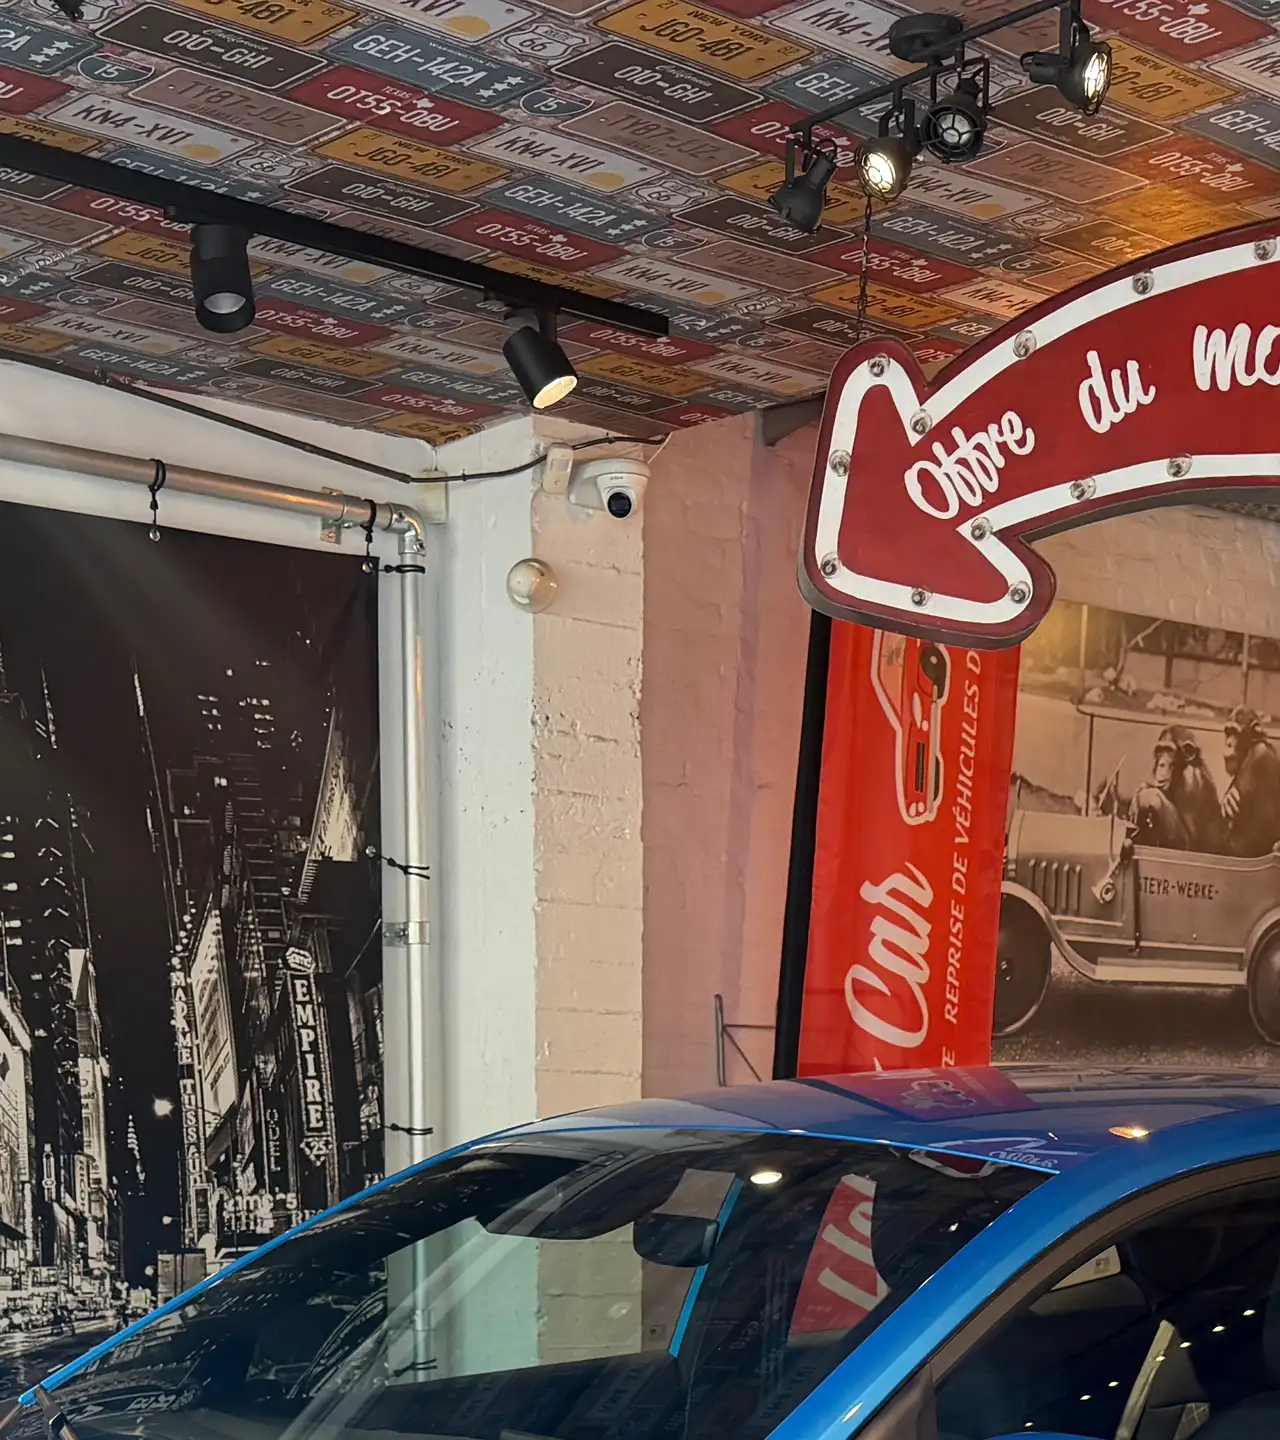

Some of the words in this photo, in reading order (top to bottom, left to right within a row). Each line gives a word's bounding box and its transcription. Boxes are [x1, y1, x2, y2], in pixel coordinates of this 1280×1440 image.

[518, 36, 548, 52] 66
[687, 9, 729, 27] NEW
[730, 25, 776, 46] YORK
[93, 63, 127, 79] 15
[352, 34, 489, 88] GEH-142A
[905, 408, 1036, 521] Offre
[1077, 350, 1157, 434] du
[951, 683, 980, 845] VÉHICULES
[951, 852, 969, 897] DE
[944, 899, 965, 1025] REPRISE
[293, 979, 324, 1131] EMPIRE
